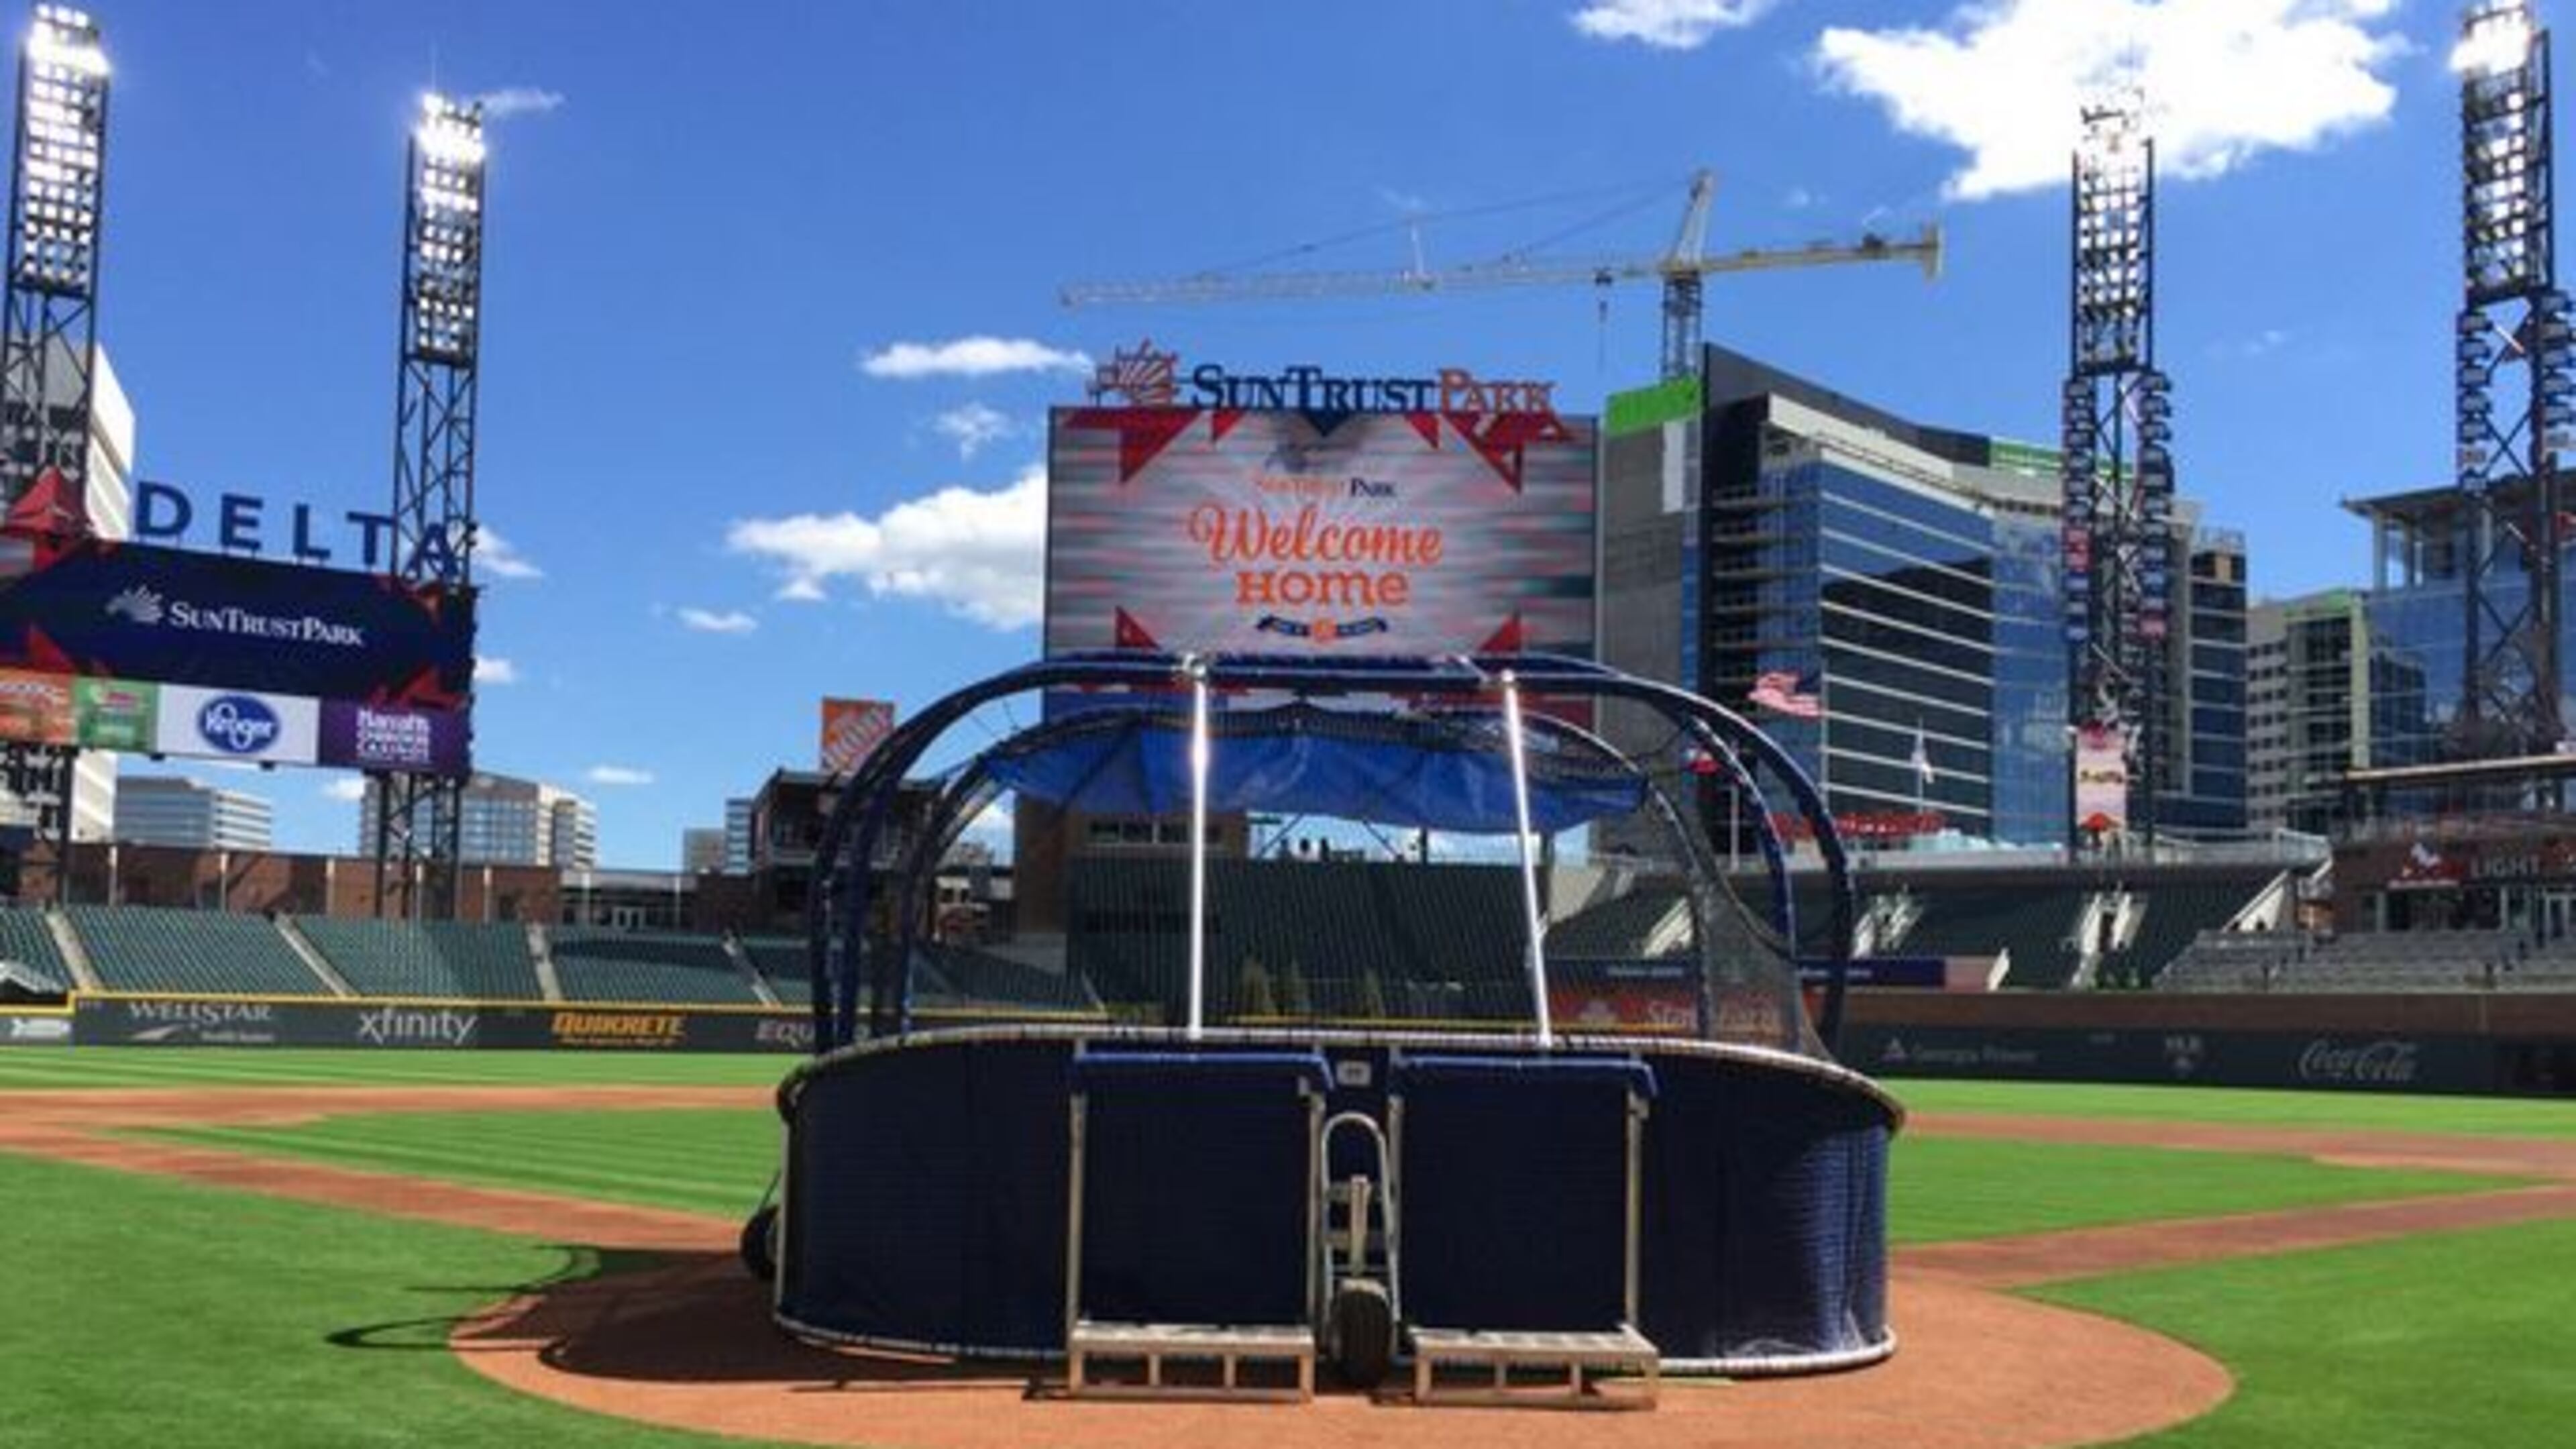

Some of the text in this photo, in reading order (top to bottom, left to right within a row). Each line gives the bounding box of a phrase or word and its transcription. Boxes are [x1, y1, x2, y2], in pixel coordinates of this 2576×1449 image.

[137, 480, 459, 586] DELTA
[1187, 502, 1443, 568] Welcome
[205, 702, 272, 750] Kroger
[358, 1005, 478, 1044] xfinity
[551, 1011, 687, 1035] QUIKRETE
